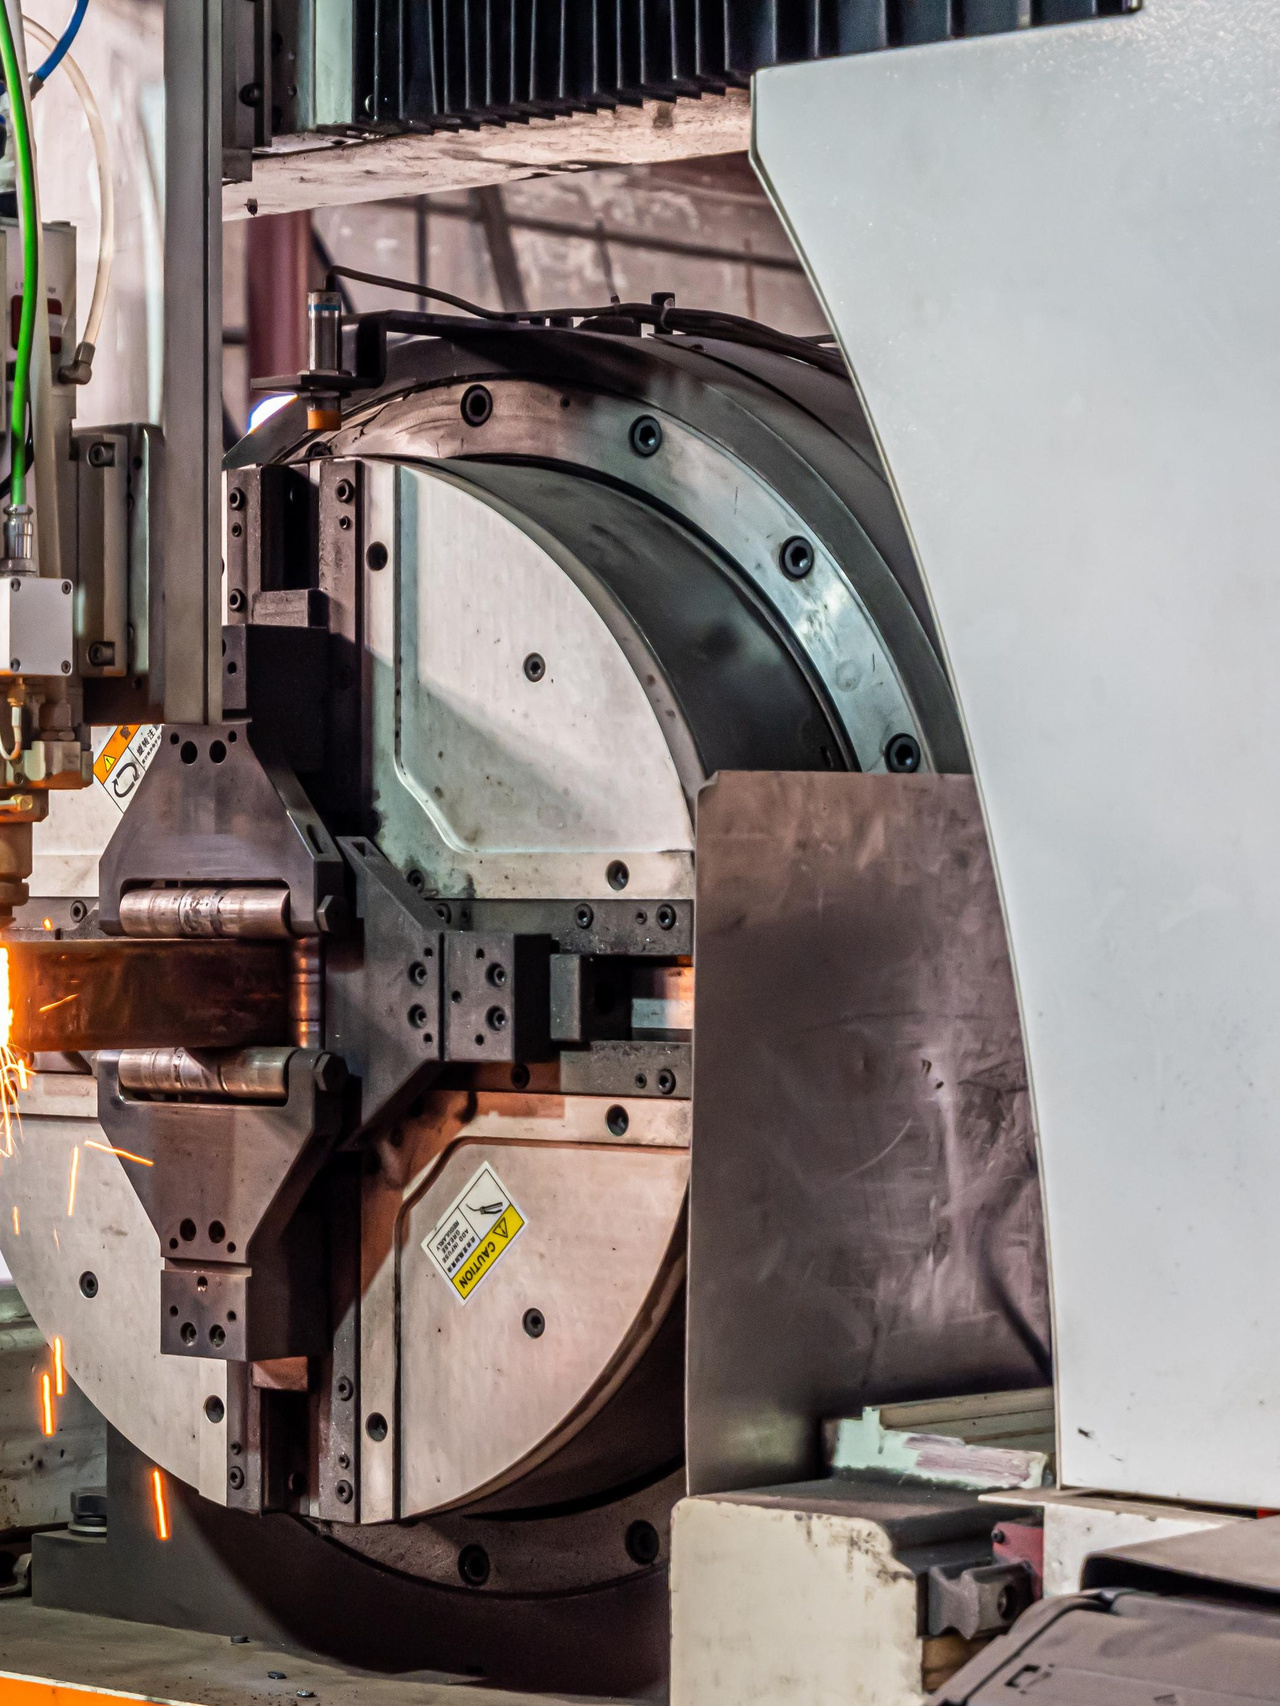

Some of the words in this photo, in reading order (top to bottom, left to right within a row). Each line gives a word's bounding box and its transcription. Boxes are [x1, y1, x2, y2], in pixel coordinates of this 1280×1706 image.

[435, 1219, 460, 1251] REGULARLY
[442, 1229, 461, 1255] GREASE
[458, 1228, 469, 1242] ADD
[459, 1241, 496, 1289] CAUTION
